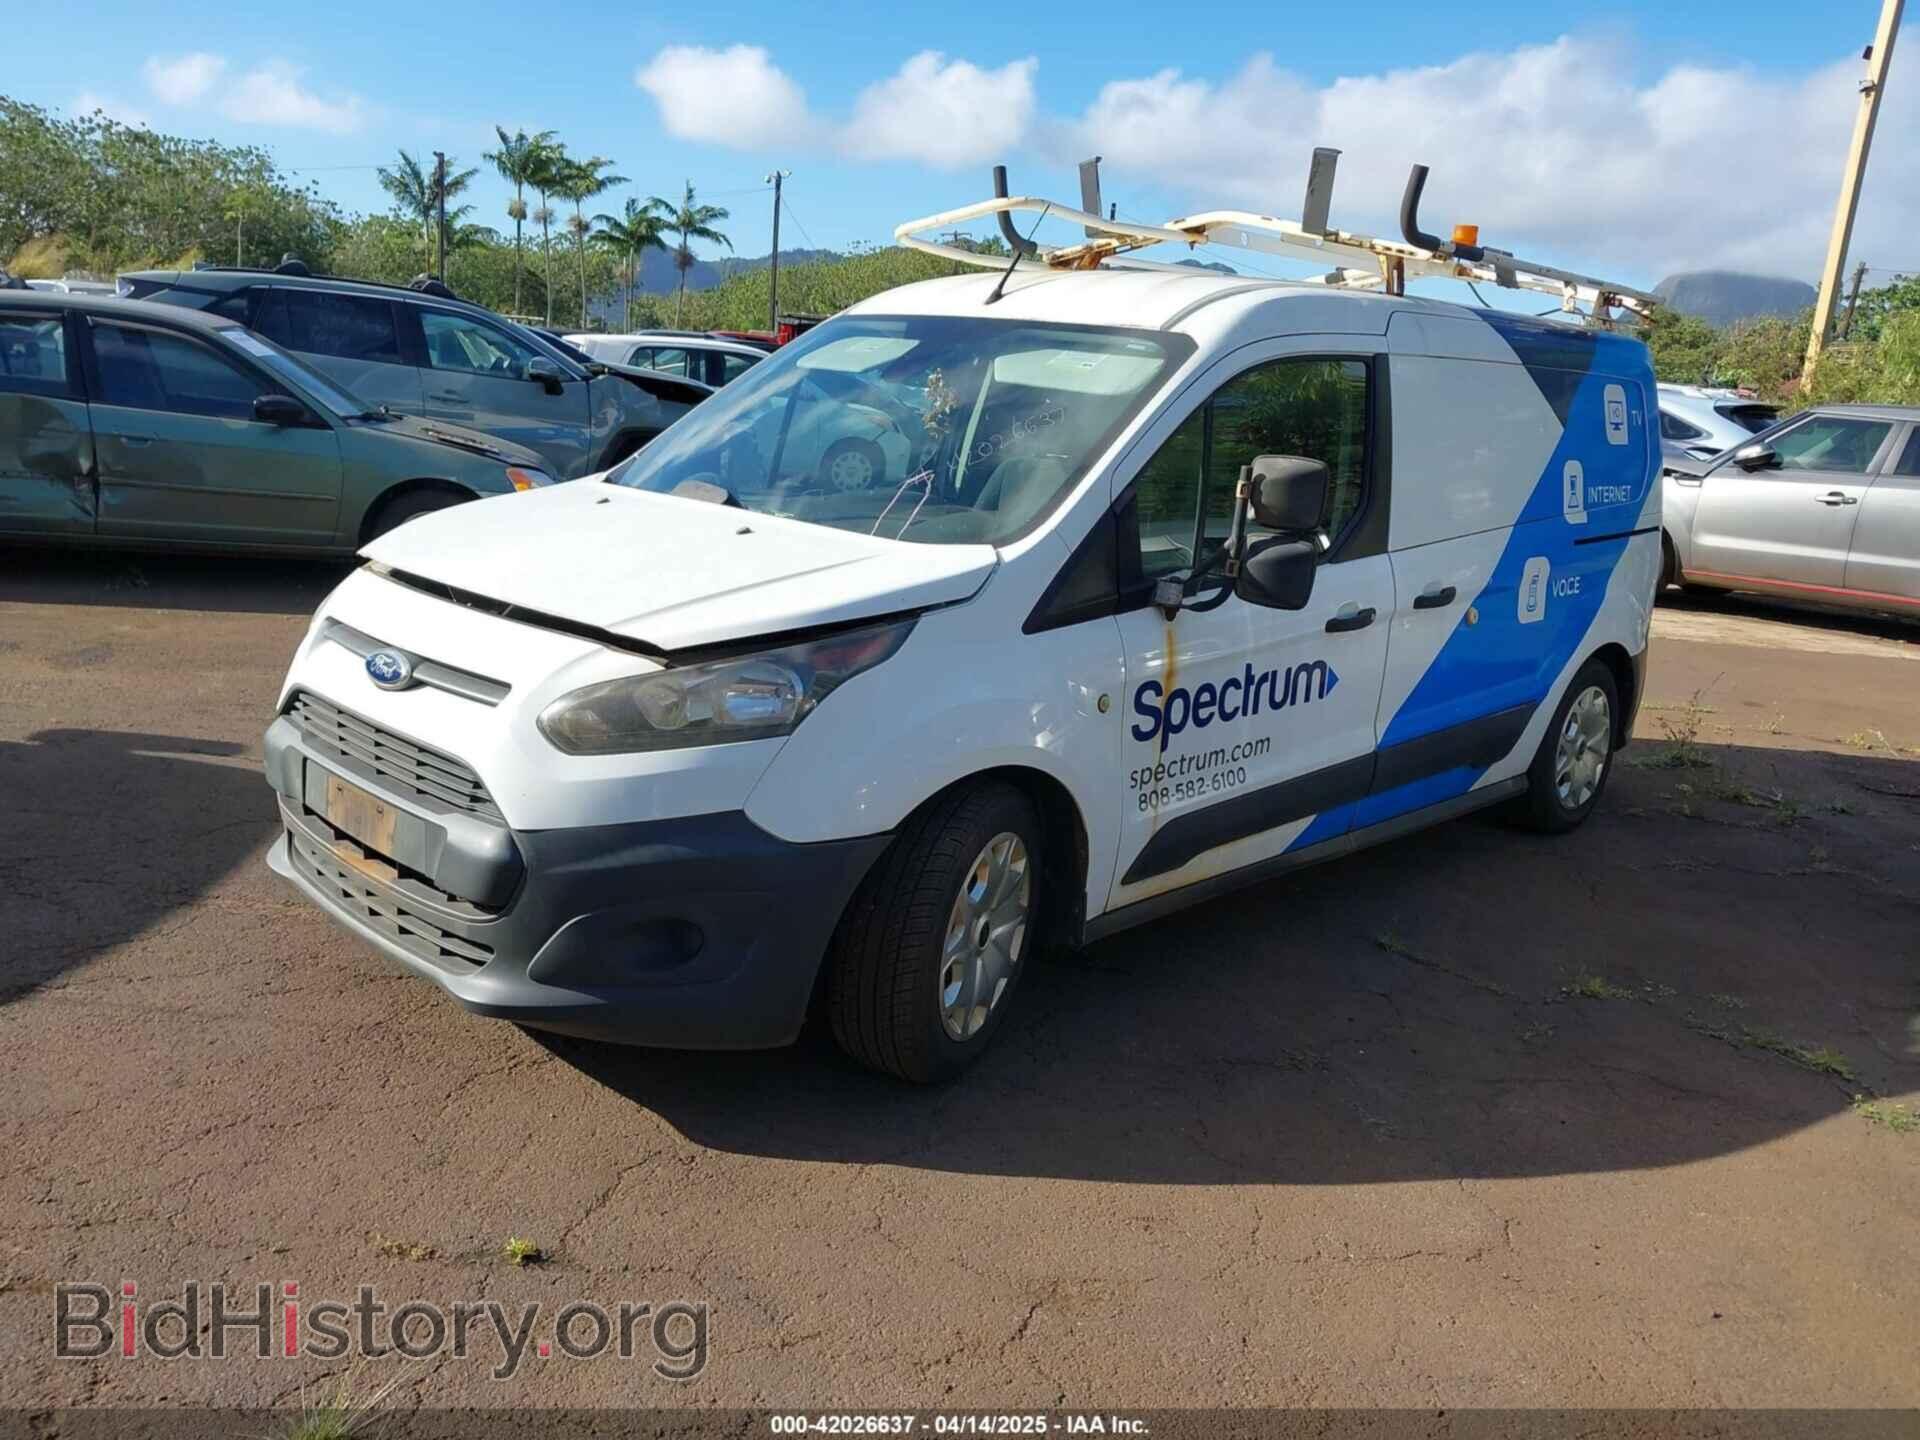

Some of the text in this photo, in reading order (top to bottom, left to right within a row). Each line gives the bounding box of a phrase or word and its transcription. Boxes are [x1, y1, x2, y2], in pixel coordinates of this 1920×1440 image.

[1631, 409, 1642, 426] TV
[1587, 485, 1632, 504] INTERNET
[1131, 659, 1328, 752] Spectrum
[1130, 737, 1271, 790] spectrum.com
[1138, 766, 1247, 812] 808-582-6100
